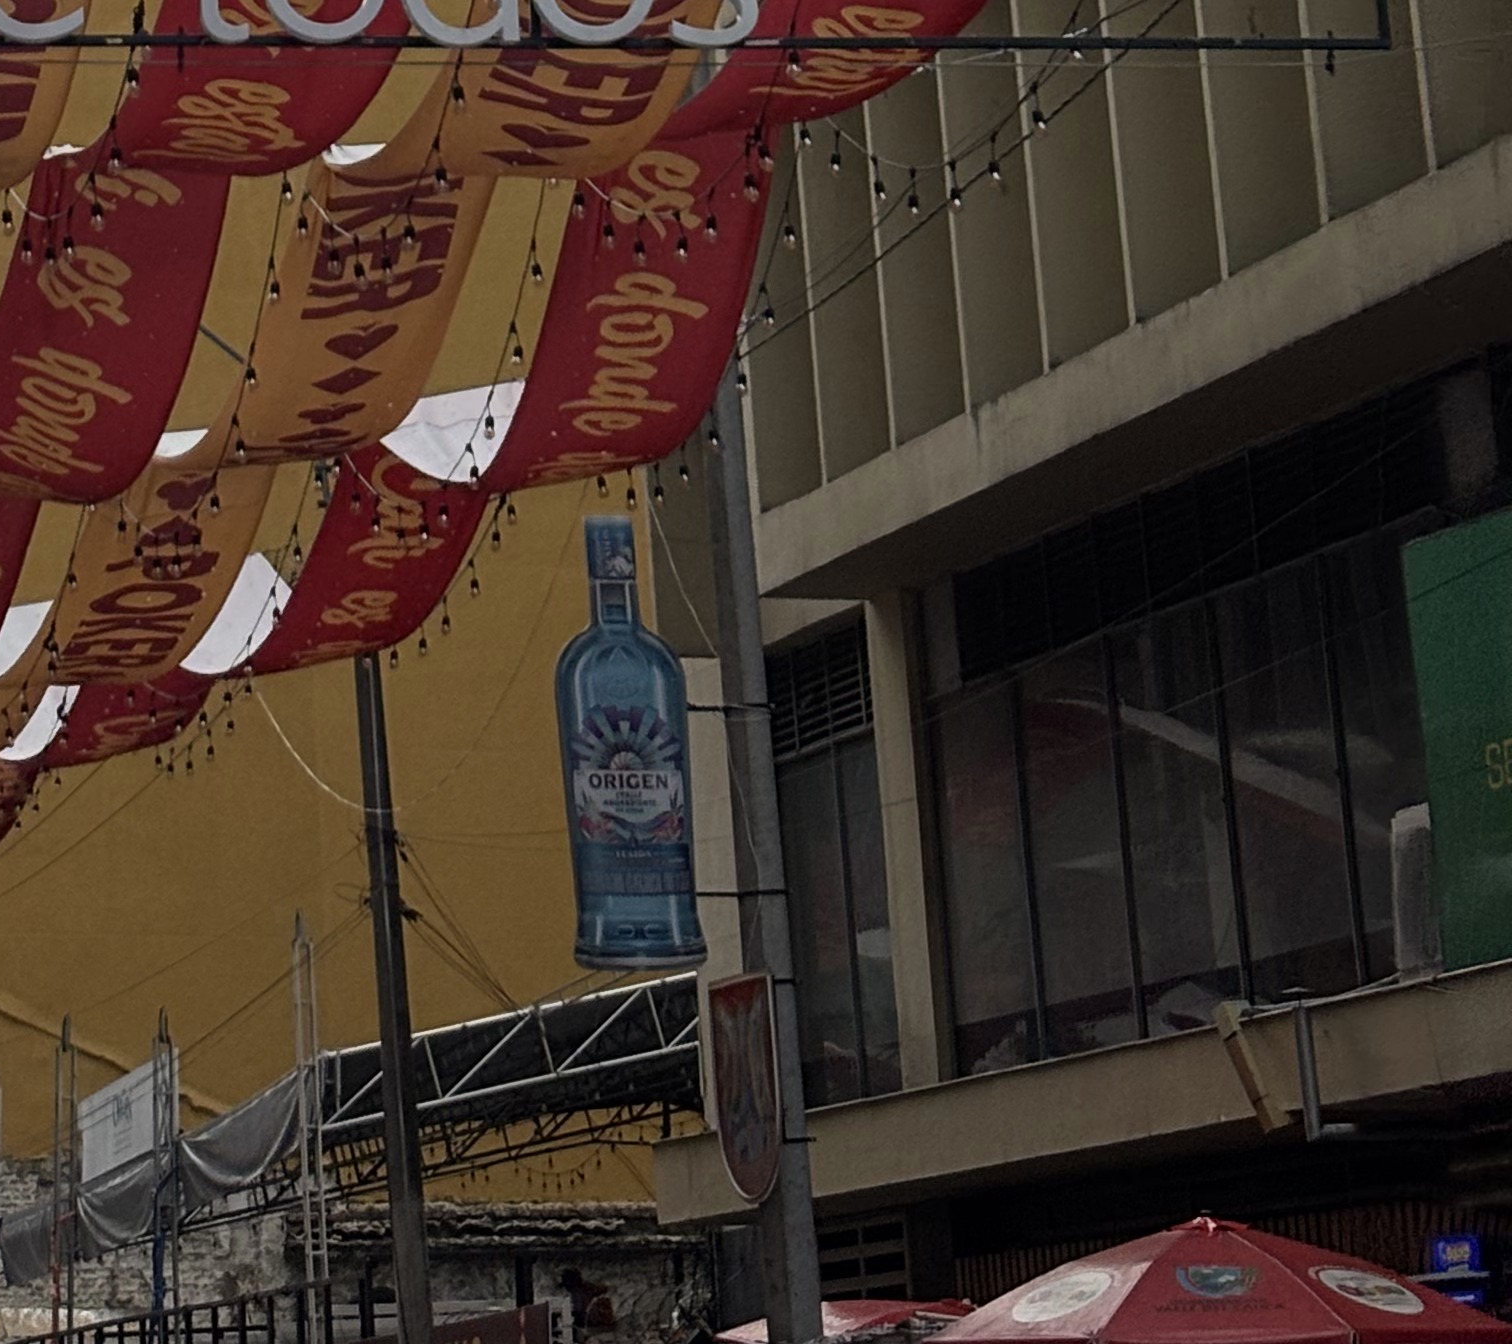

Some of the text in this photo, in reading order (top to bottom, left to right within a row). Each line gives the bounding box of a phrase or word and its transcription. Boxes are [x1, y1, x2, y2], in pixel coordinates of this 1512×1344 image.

[609, 150, 702, 243] es
[37, 244, 134, 327] es
[301, 175, 464, 321] KER
[558, 272, 710, 437] donde
[588, 772, 670, 791] ORIGEN
